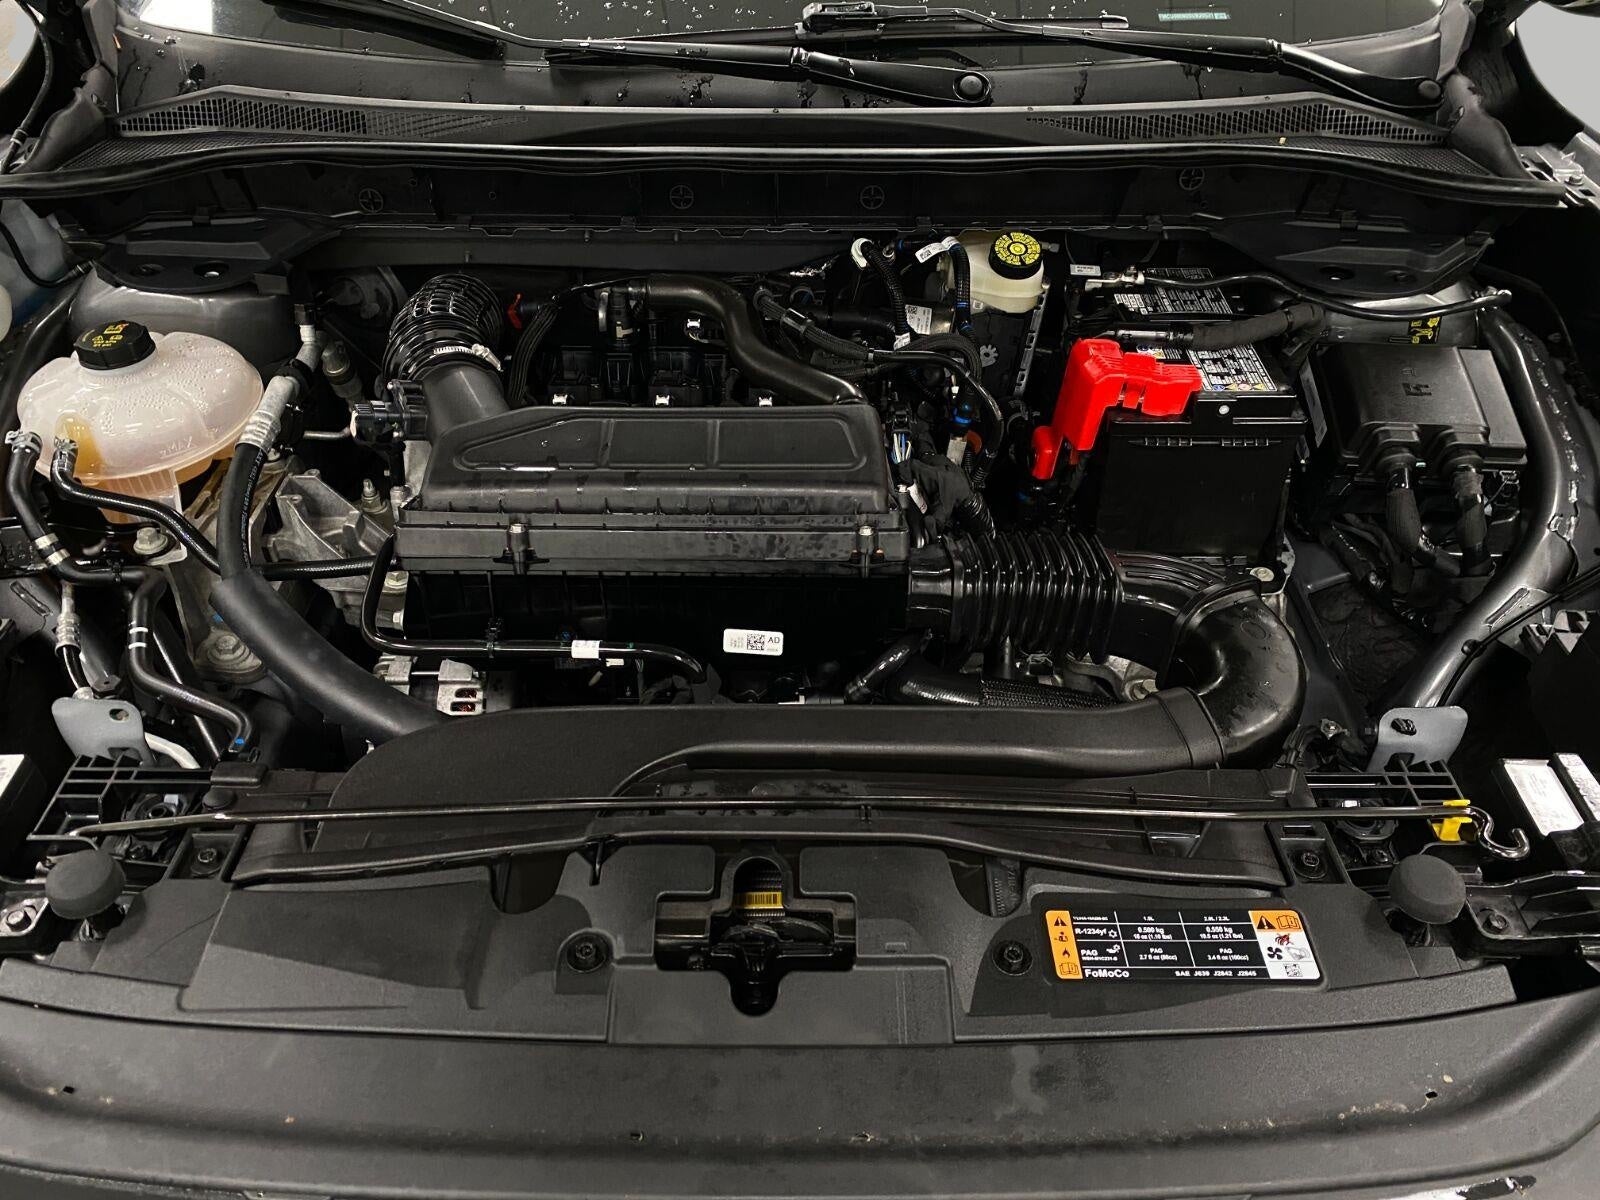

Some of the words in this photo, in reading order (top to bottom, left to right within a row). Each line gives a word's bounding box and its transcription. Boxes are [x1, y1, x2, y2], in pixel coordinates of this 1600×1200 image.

[767, 636, 781, 644] AD
[1075, 928, 1107, 936] R-1234yf
[1155, 926, 1165, 935] kg
[1223, 926, 1233, 934] kg
[1085, 969, 1130, 978] FoMoCo
